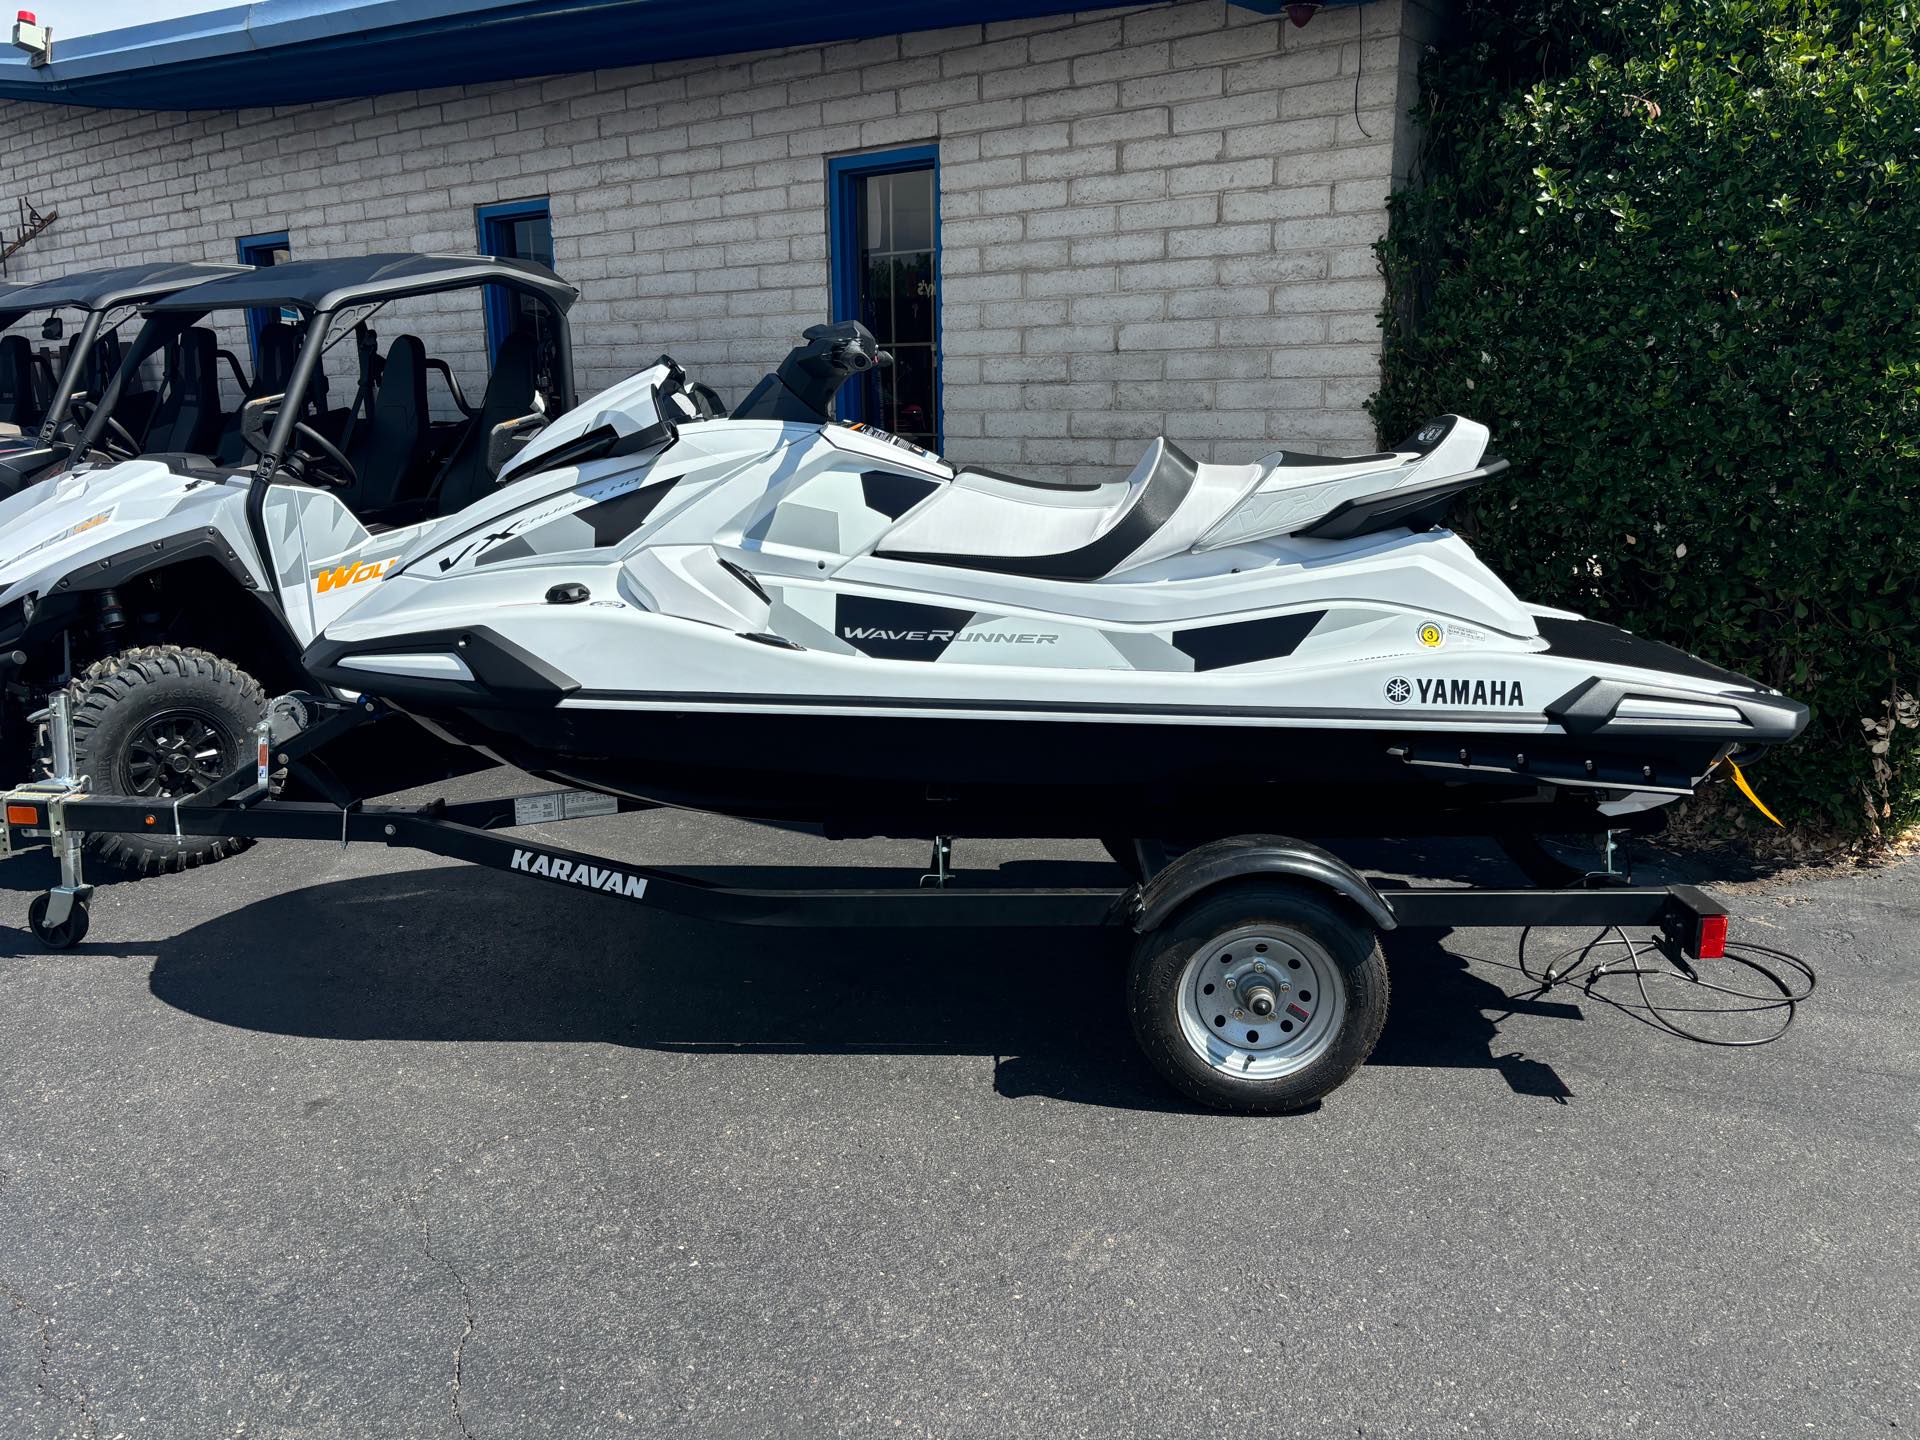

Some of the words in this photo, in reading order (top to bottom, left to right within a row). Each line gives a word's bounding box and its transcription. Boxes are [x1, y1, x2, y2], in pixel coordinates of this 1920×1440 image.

[438, 518, 526, 573] VX
[517, 490, 605, 530] CRUISER
[609, 477, 641, 492] HO
[1426, 630, 1434, 640] 3
[1416, 678, 1524, 706] YAMAHA
[510, 848, 648, 899] KARAVAN
